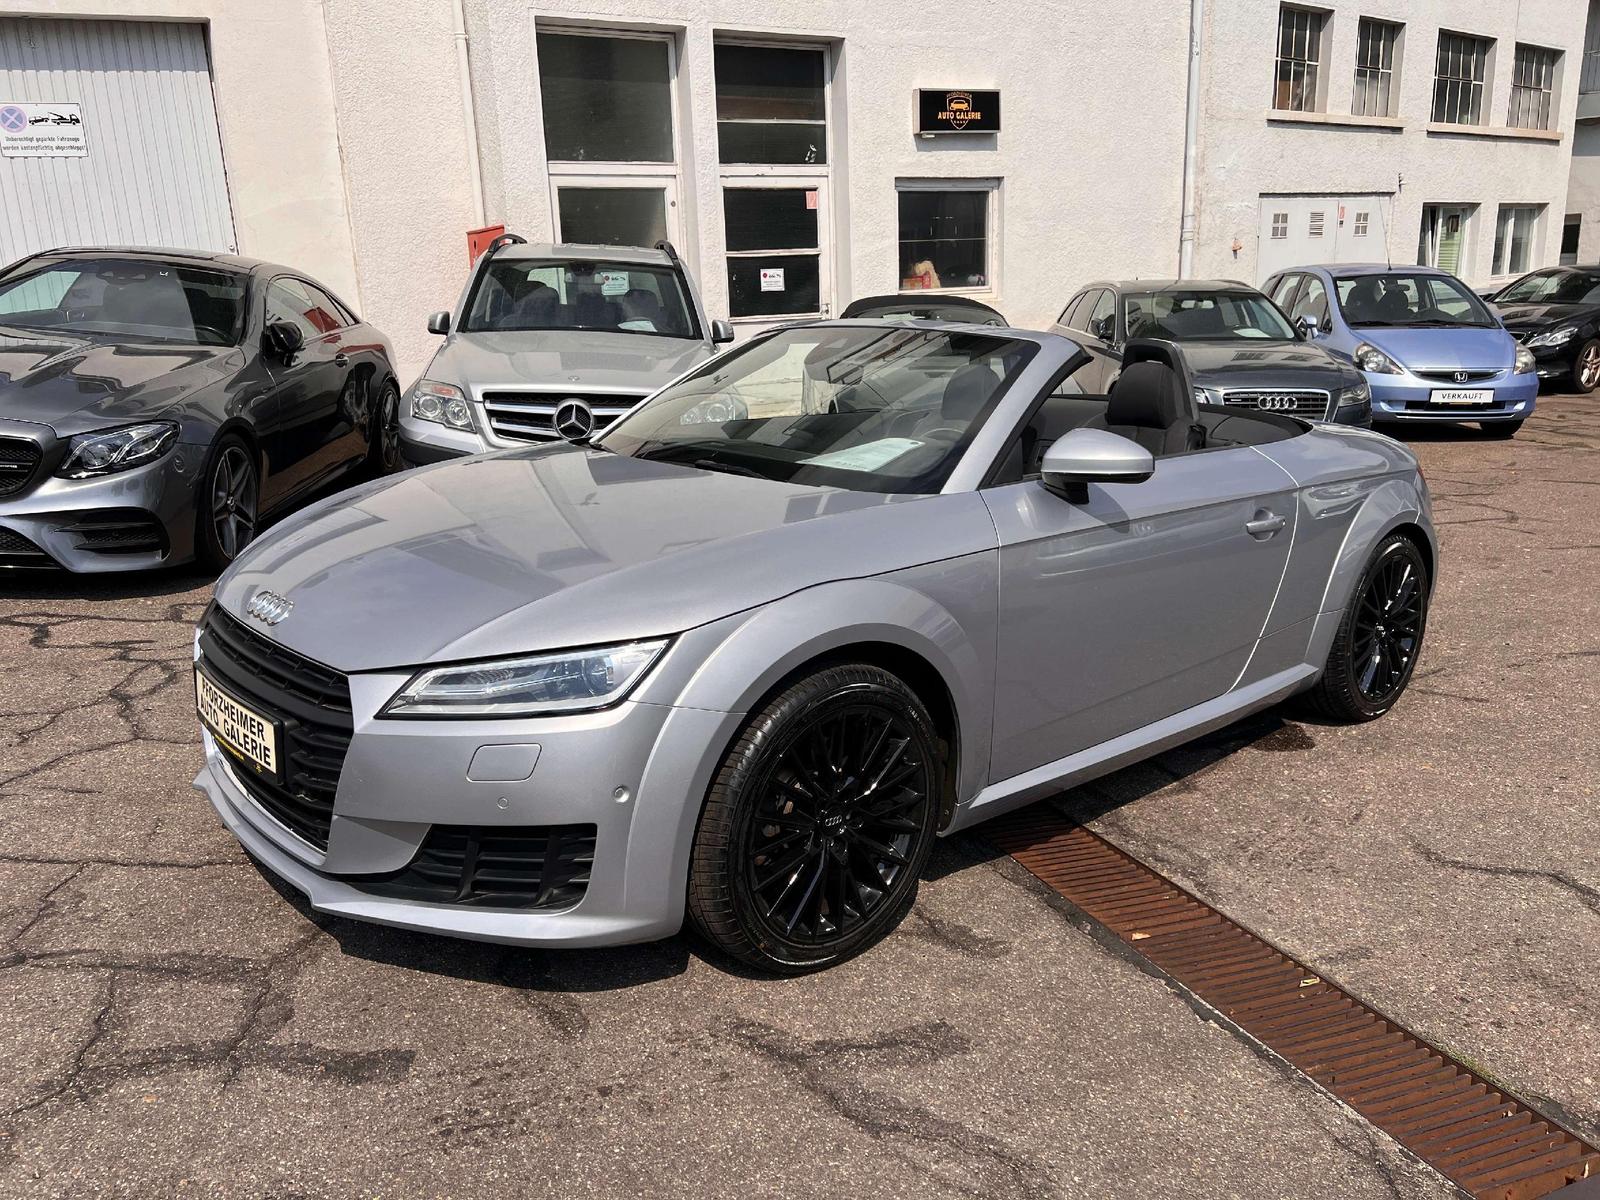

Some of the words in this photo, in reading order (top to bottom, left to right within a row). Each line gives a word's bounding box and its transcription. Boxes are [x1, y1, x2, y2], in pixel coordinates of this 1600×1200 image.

[938, 111, 954, 119] AUTO
[956, 111, 981, 119] GALERIE
[1441, 392, 1483, 400] VERKAUFT
[202, 677, 265, 742] PFORZHEIMER
[200, 693, 219, 727] AUTO
[223, 718, 271, 767] GALERIE
